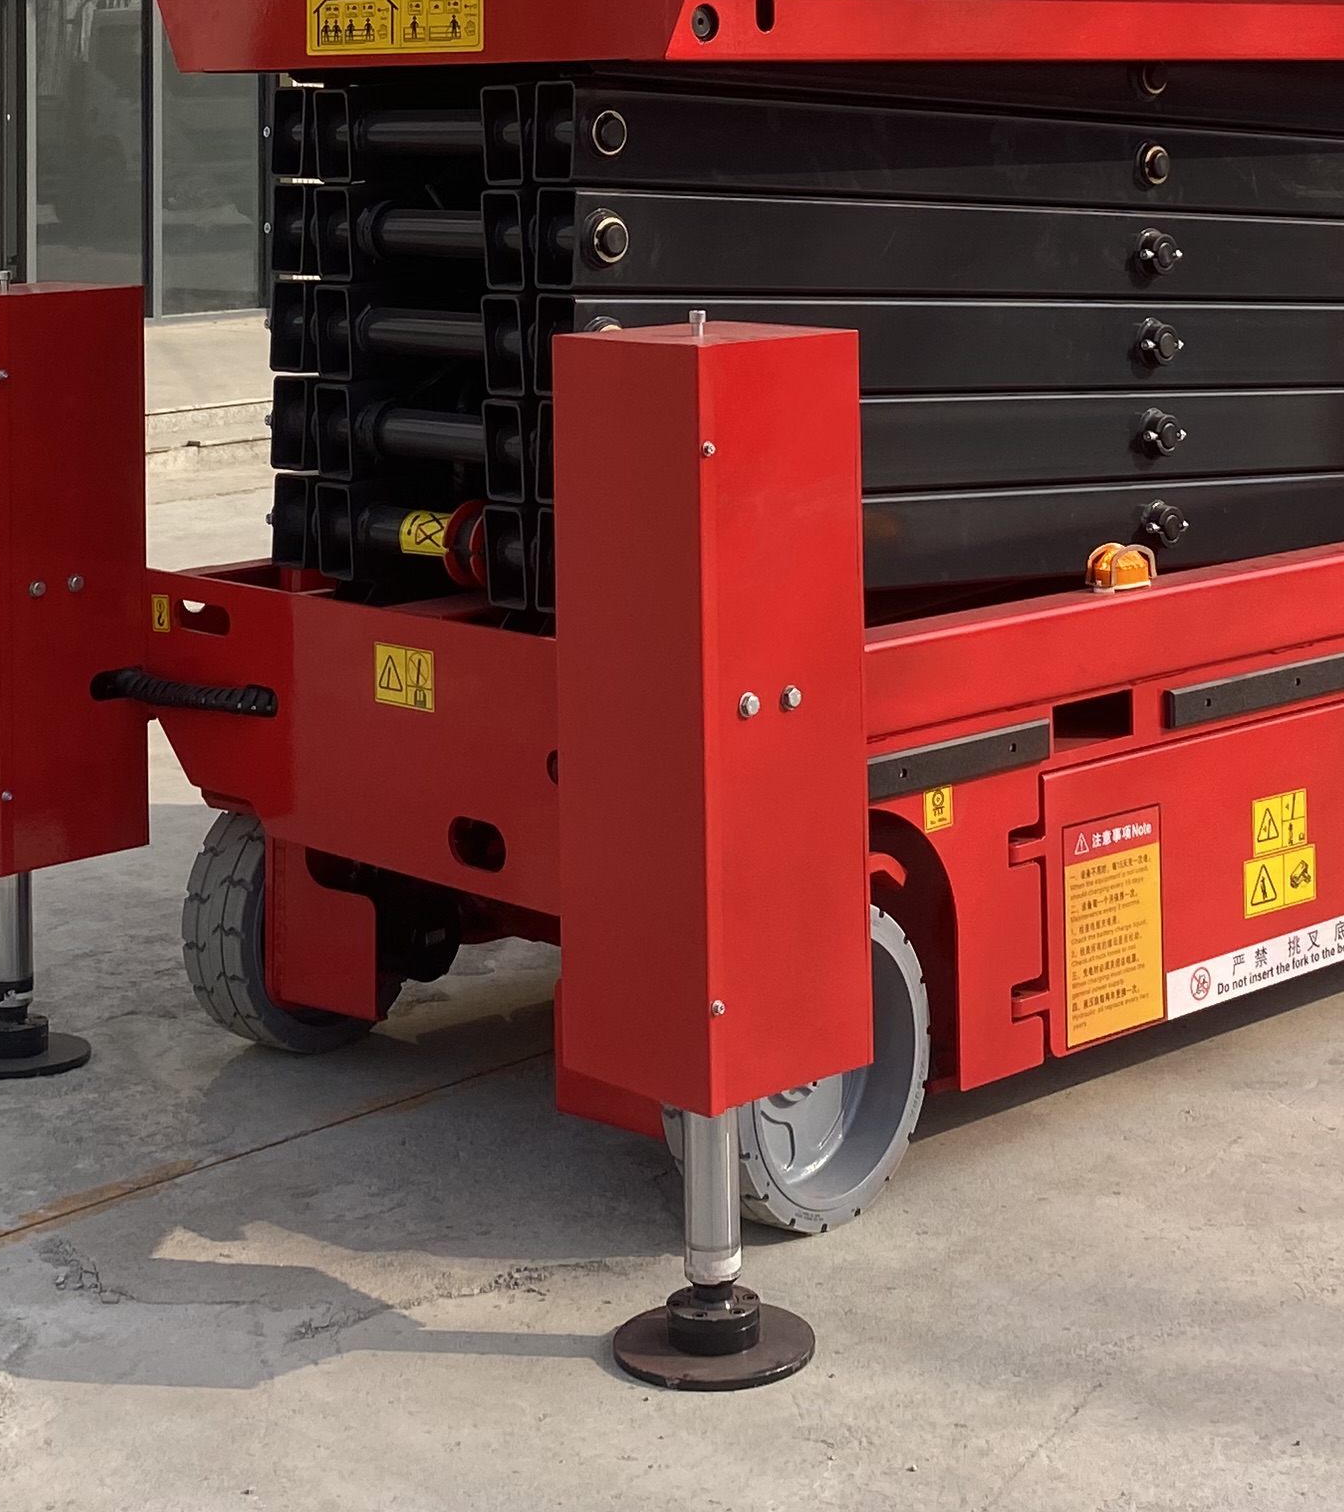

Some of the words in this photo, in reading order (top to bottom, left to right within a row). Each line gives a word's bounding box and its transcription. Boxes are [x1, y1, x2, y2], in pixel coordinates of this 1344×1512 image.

[1217, 982, 1230, 996] Do
[1232, 975, 1247, 990] not
[1249, 968, 1275, 986] insert
[1276, 962, 1290, 975] the
[1292, 956, 1309, 970] fork
[1311, 953, 1320, 964] to
[1321, 947, 1336, 960] the
